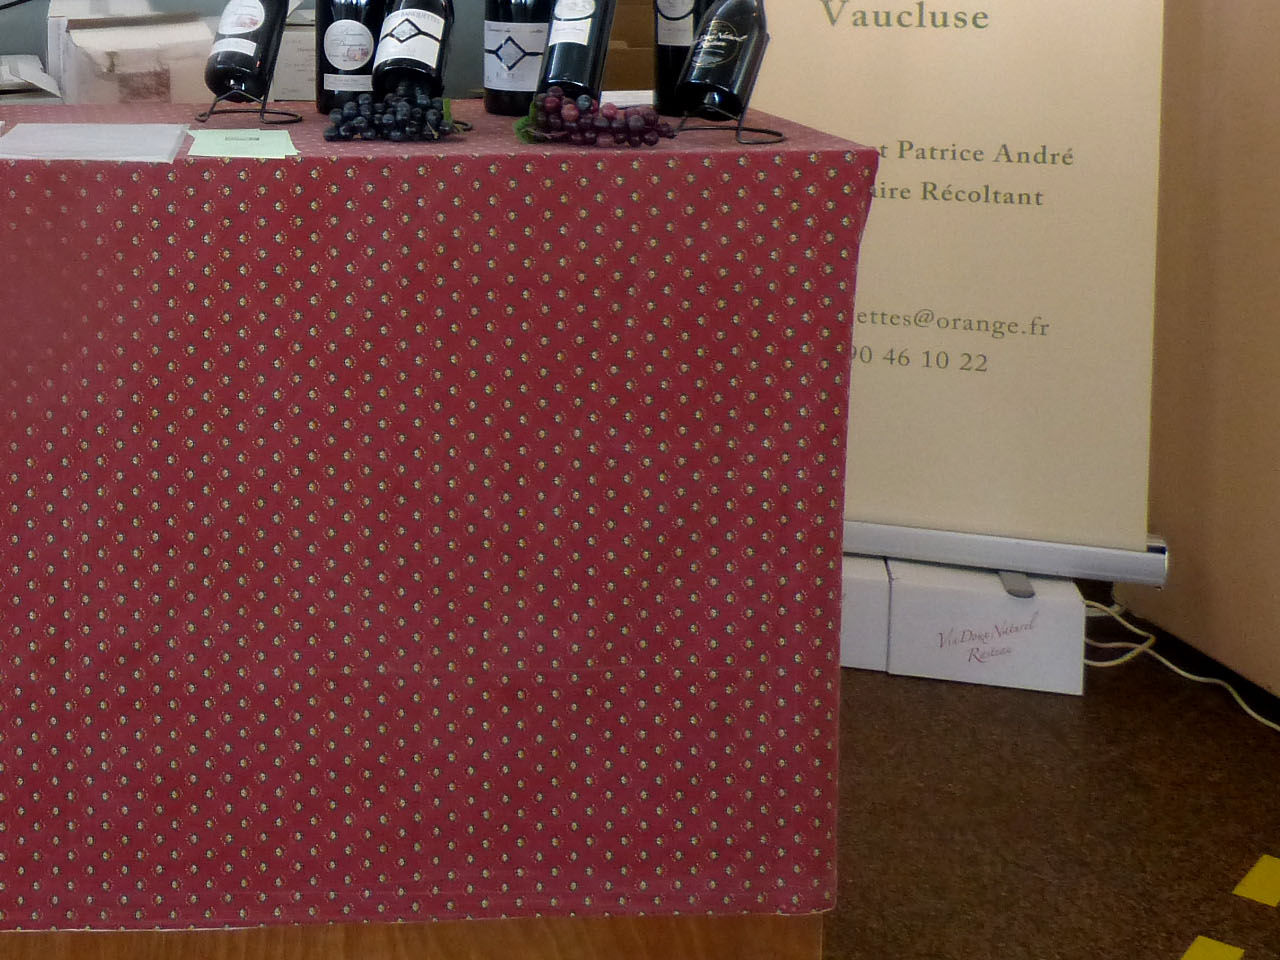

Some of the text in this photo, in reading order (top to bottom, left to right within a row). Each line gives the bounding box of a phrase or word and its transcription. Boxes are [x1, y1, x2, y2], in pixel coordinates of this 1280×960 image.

[820, 0, 990, 29] Vaucluse
[880, 140, 1074, 166] t Patrice André
[921, 181, 1044, 205] Récoltant
[856, 308, 1050, 339] ettes@orange.fr
[882, 348, 910, 367] 46
[922, 350, 950, 369] 10
[959, 352, 988, 372] 22
